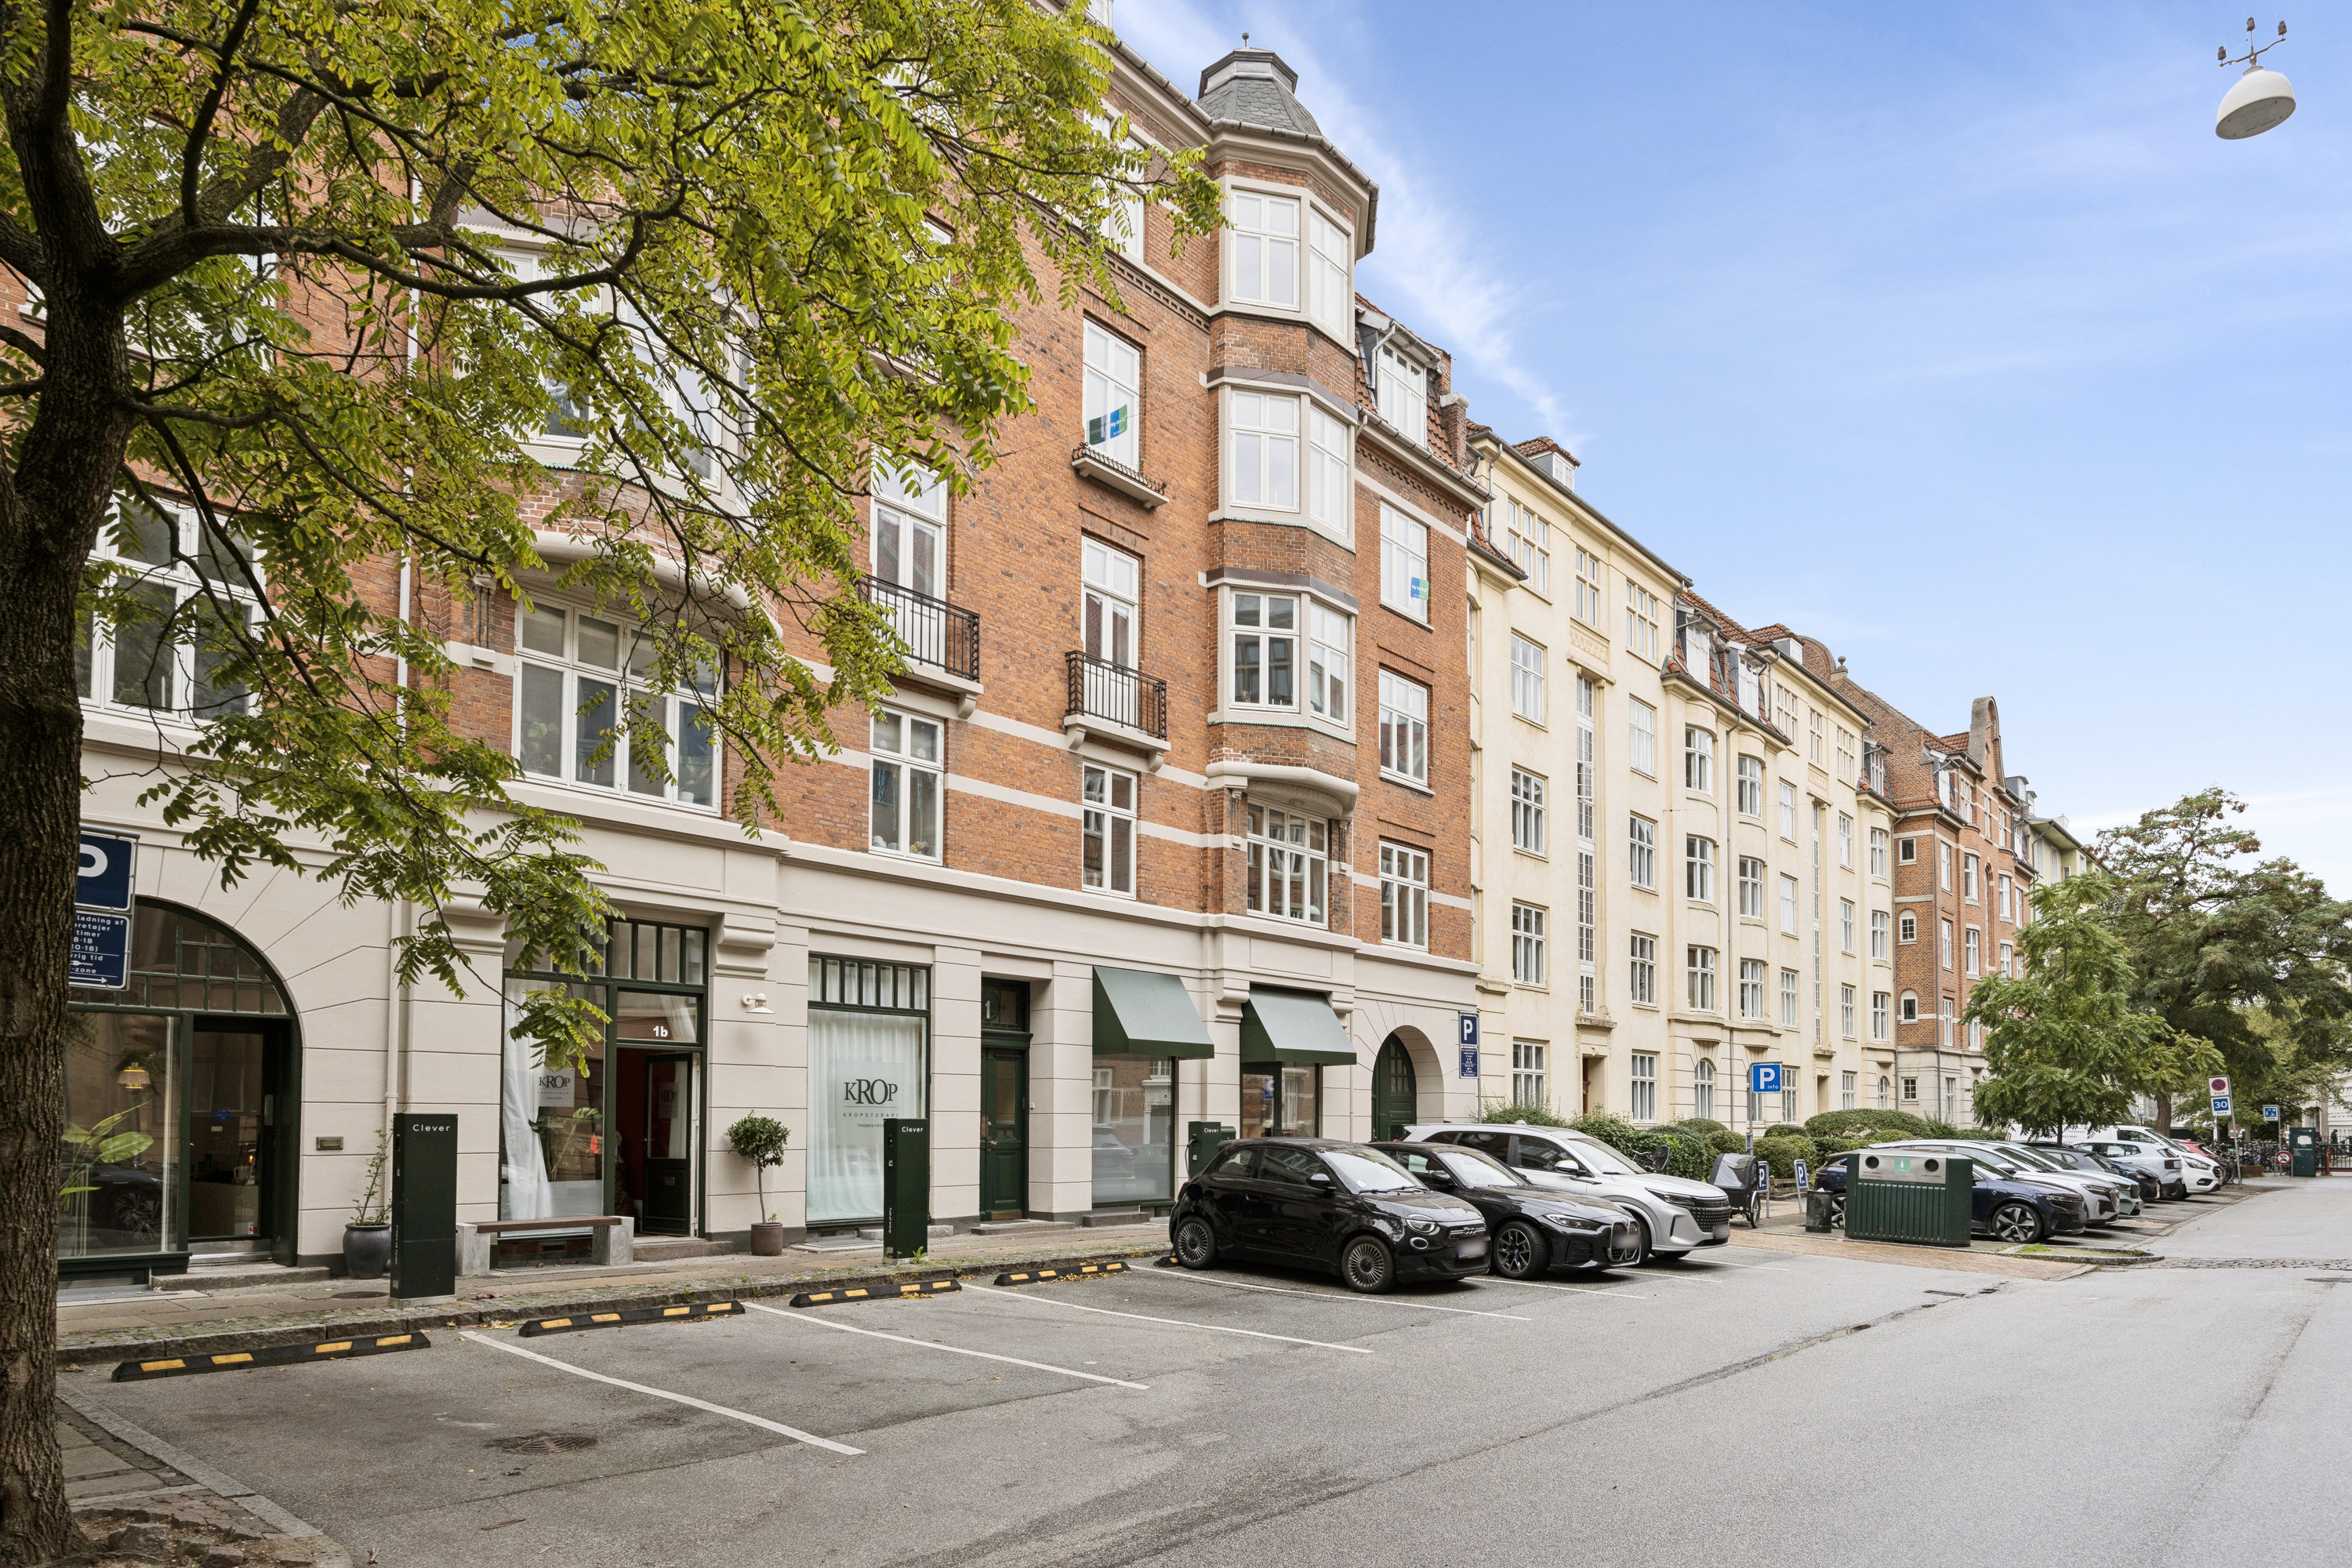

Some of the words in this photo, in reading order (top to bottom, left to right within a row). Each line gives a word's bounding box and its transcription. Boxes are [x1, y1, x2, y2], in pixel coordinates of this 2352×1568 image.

[77, 915, 111, 925] ladning
[653, 1025, 669, 1037] 1b
[1464, 1019, 1473, 1041] P
[539, 1075, 571, 1089] KROP
[1760, 1068, 1776, 1089] P
[844, 1079, 898, 1105] KROP
[1759, 1168, 1765, 1188] P
[1798, 1166, 1804, 1184] P
